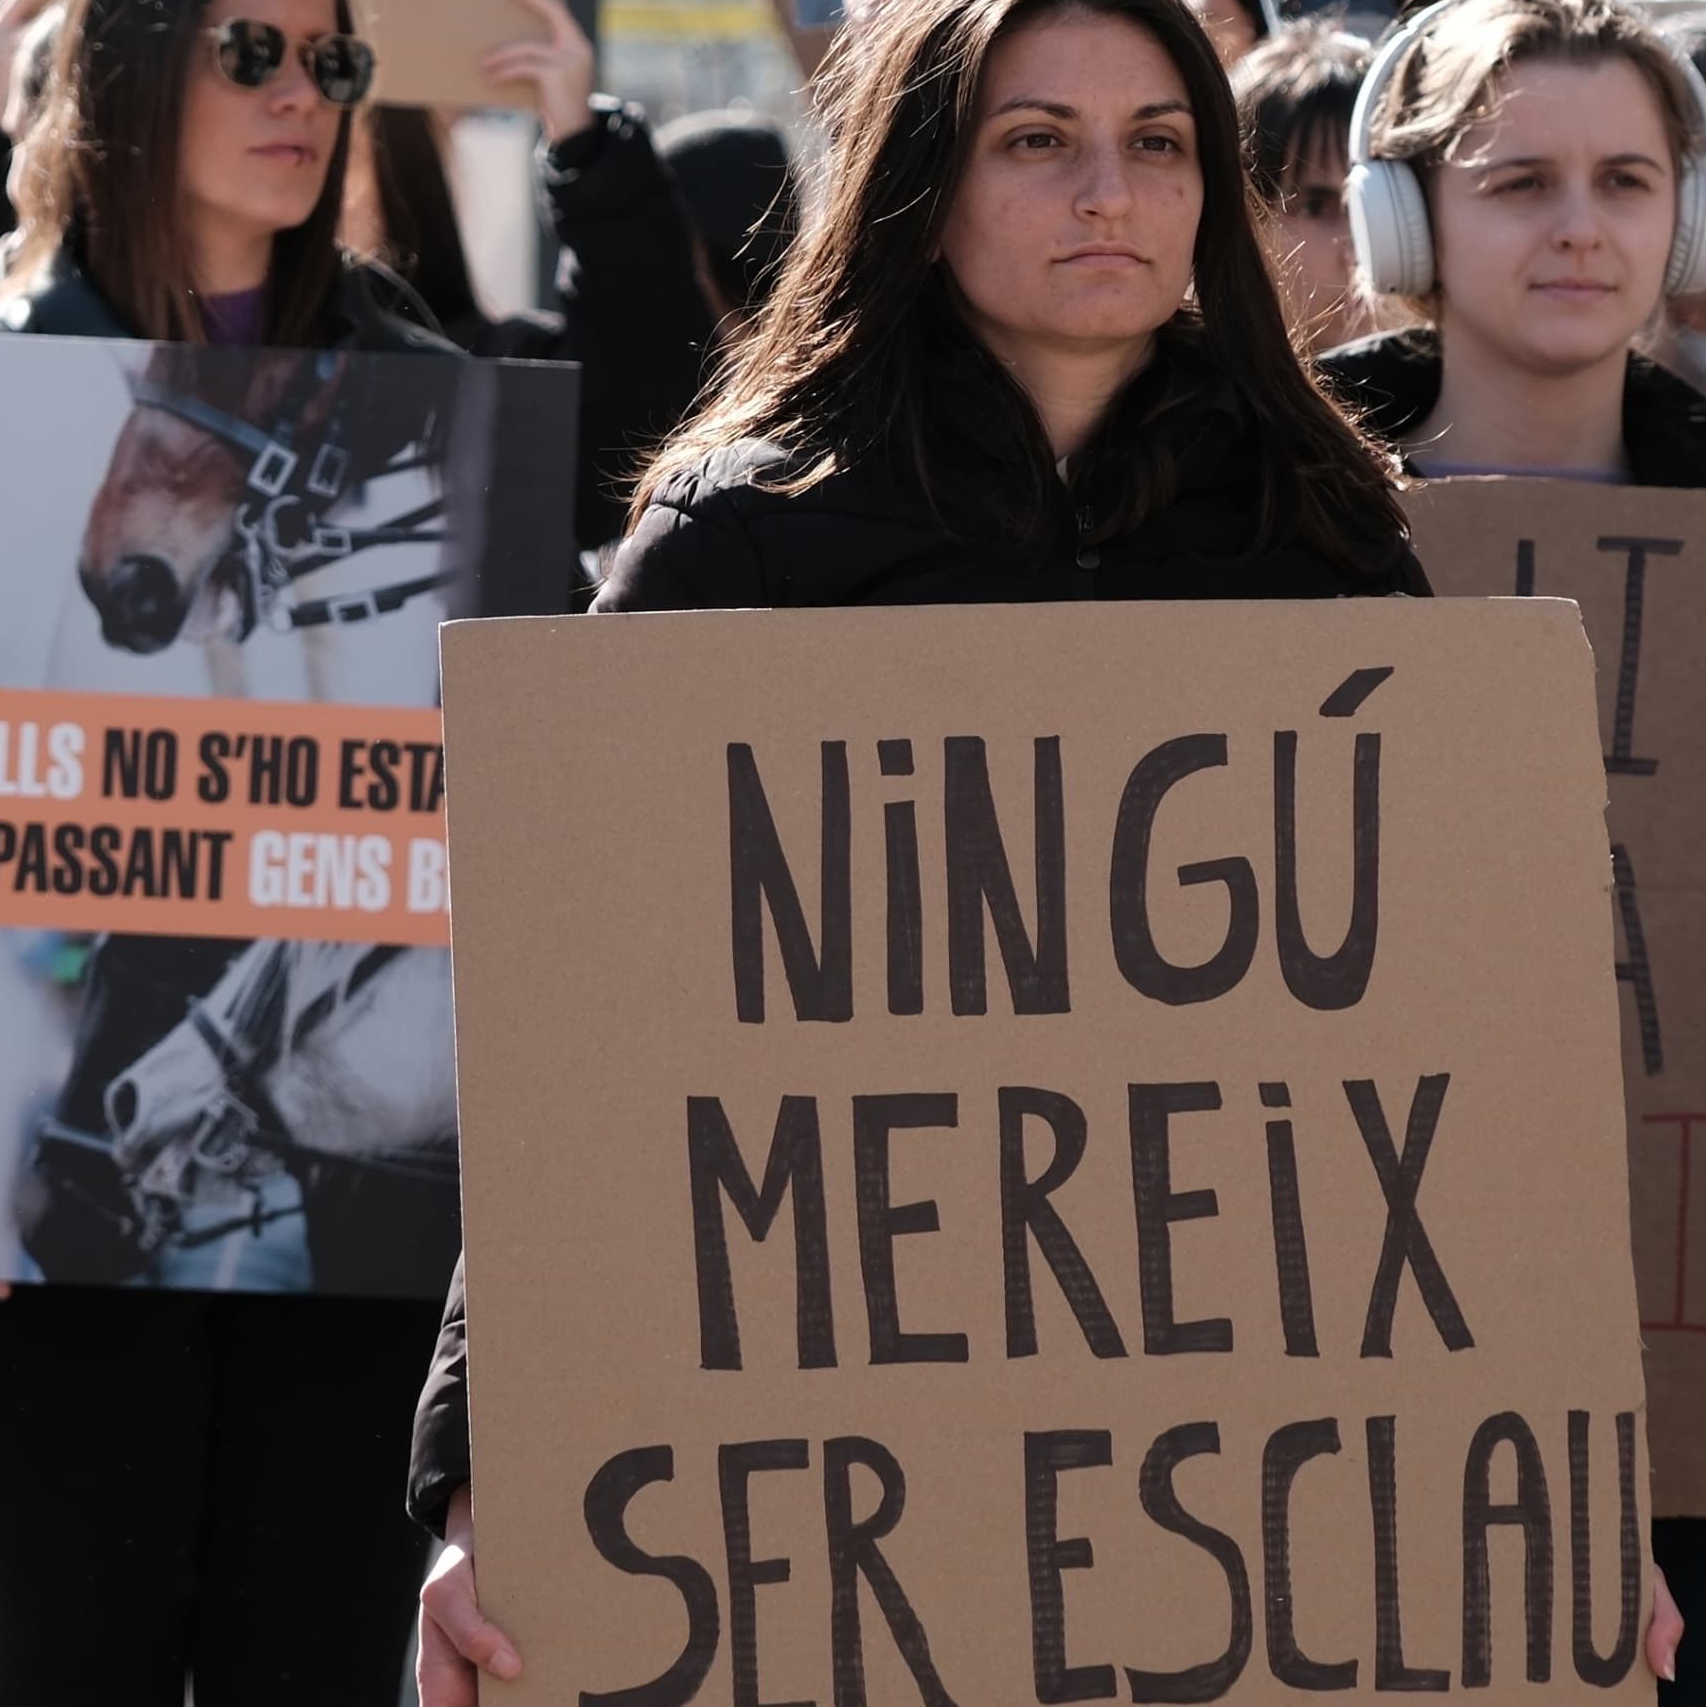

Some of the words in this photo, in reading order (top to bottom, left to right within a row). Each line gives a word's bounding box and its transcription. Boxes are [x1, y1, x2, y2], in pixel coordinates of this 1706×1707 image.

[102, 727, 178, 801] NO
[198, 731, 319, 811] S'HO
[247, 830, 391, 913] GENS
[406, 837, 450, 914] B
[576, 1435, 962, 1707] SER
[1023, 1409, 1642, 1704] ESCLAU
